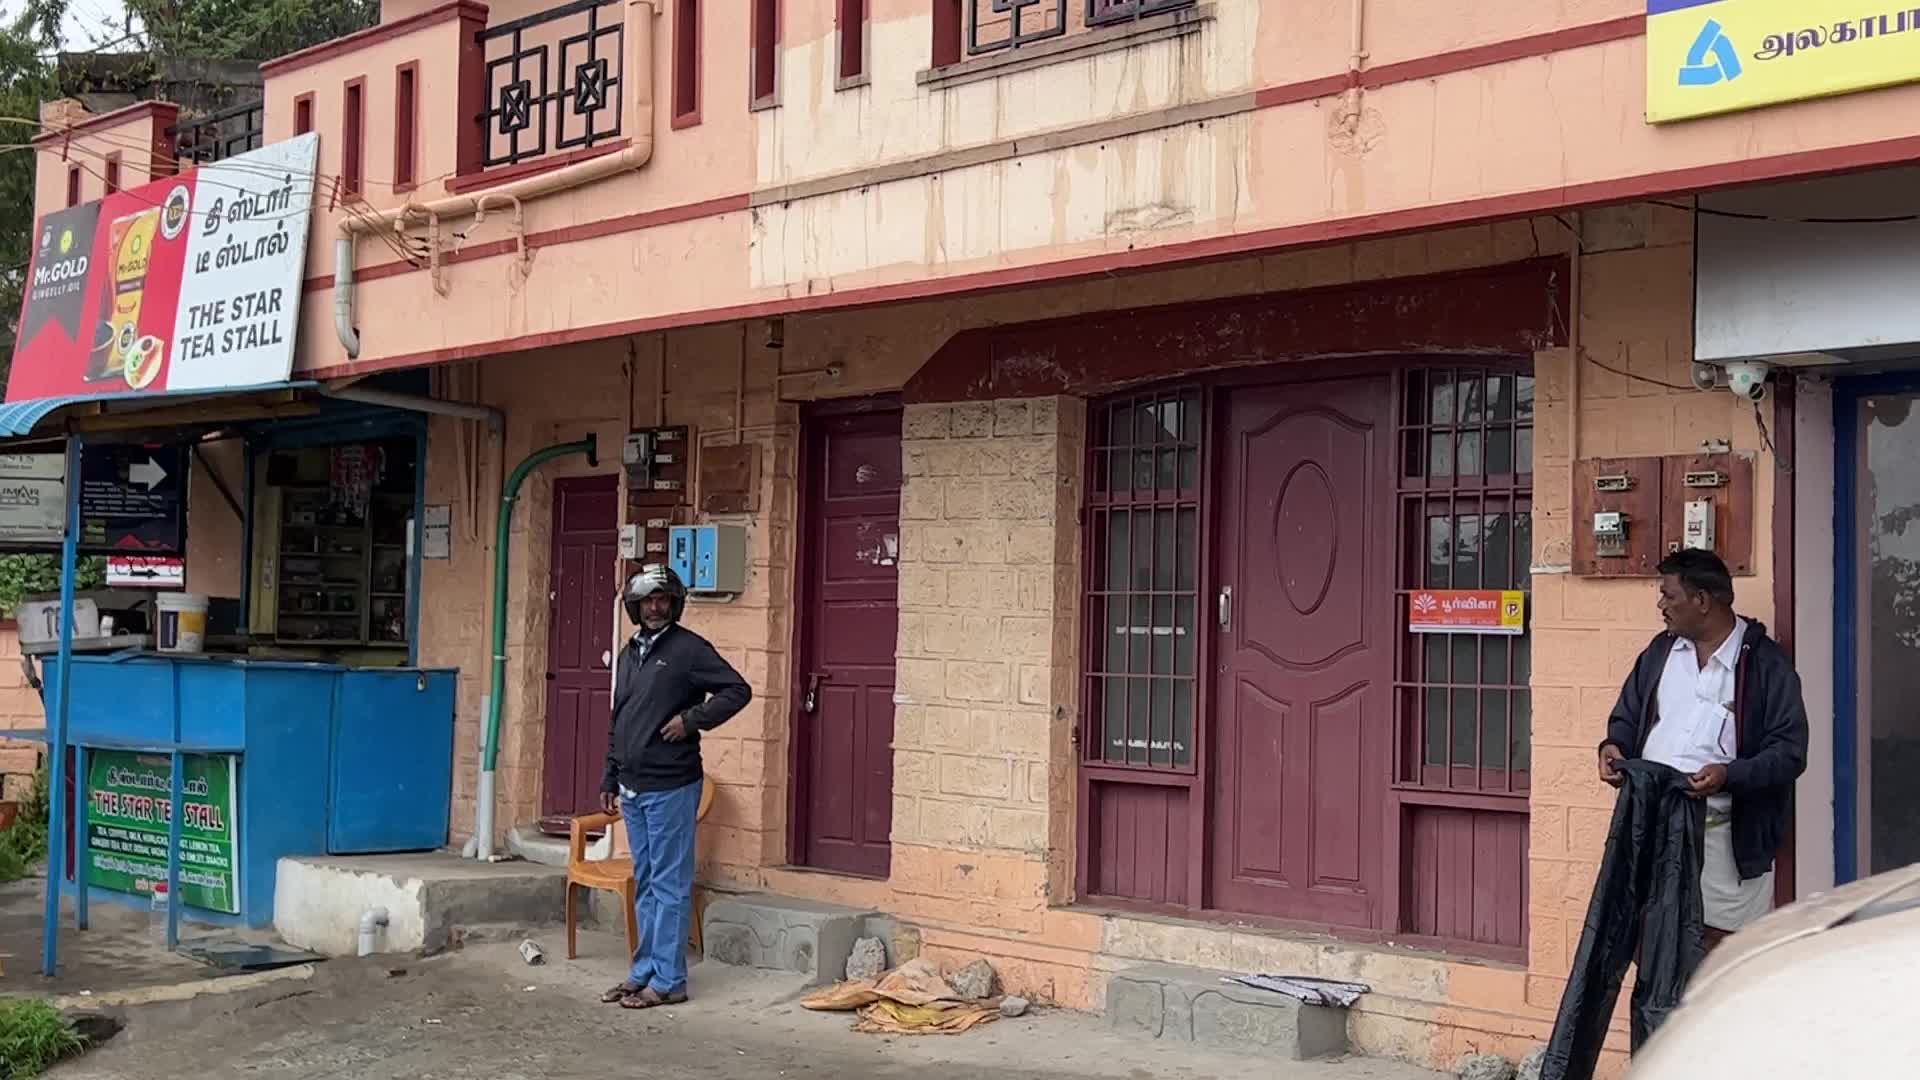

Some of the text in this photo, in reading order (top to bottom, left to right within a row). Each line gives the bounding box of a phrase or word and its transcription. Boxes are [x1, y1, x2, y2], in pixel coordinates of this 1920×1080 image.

[203, 174, 293, 237] தி ஸ்டார்
[195, 219, 289, 274] டீ ஸ்டால்
[189, 288, 283, 329] THE STAR
[180, 319, 283, 361] TEA STALL
[95, 790, 225, 831] THE STAR TE STALL
